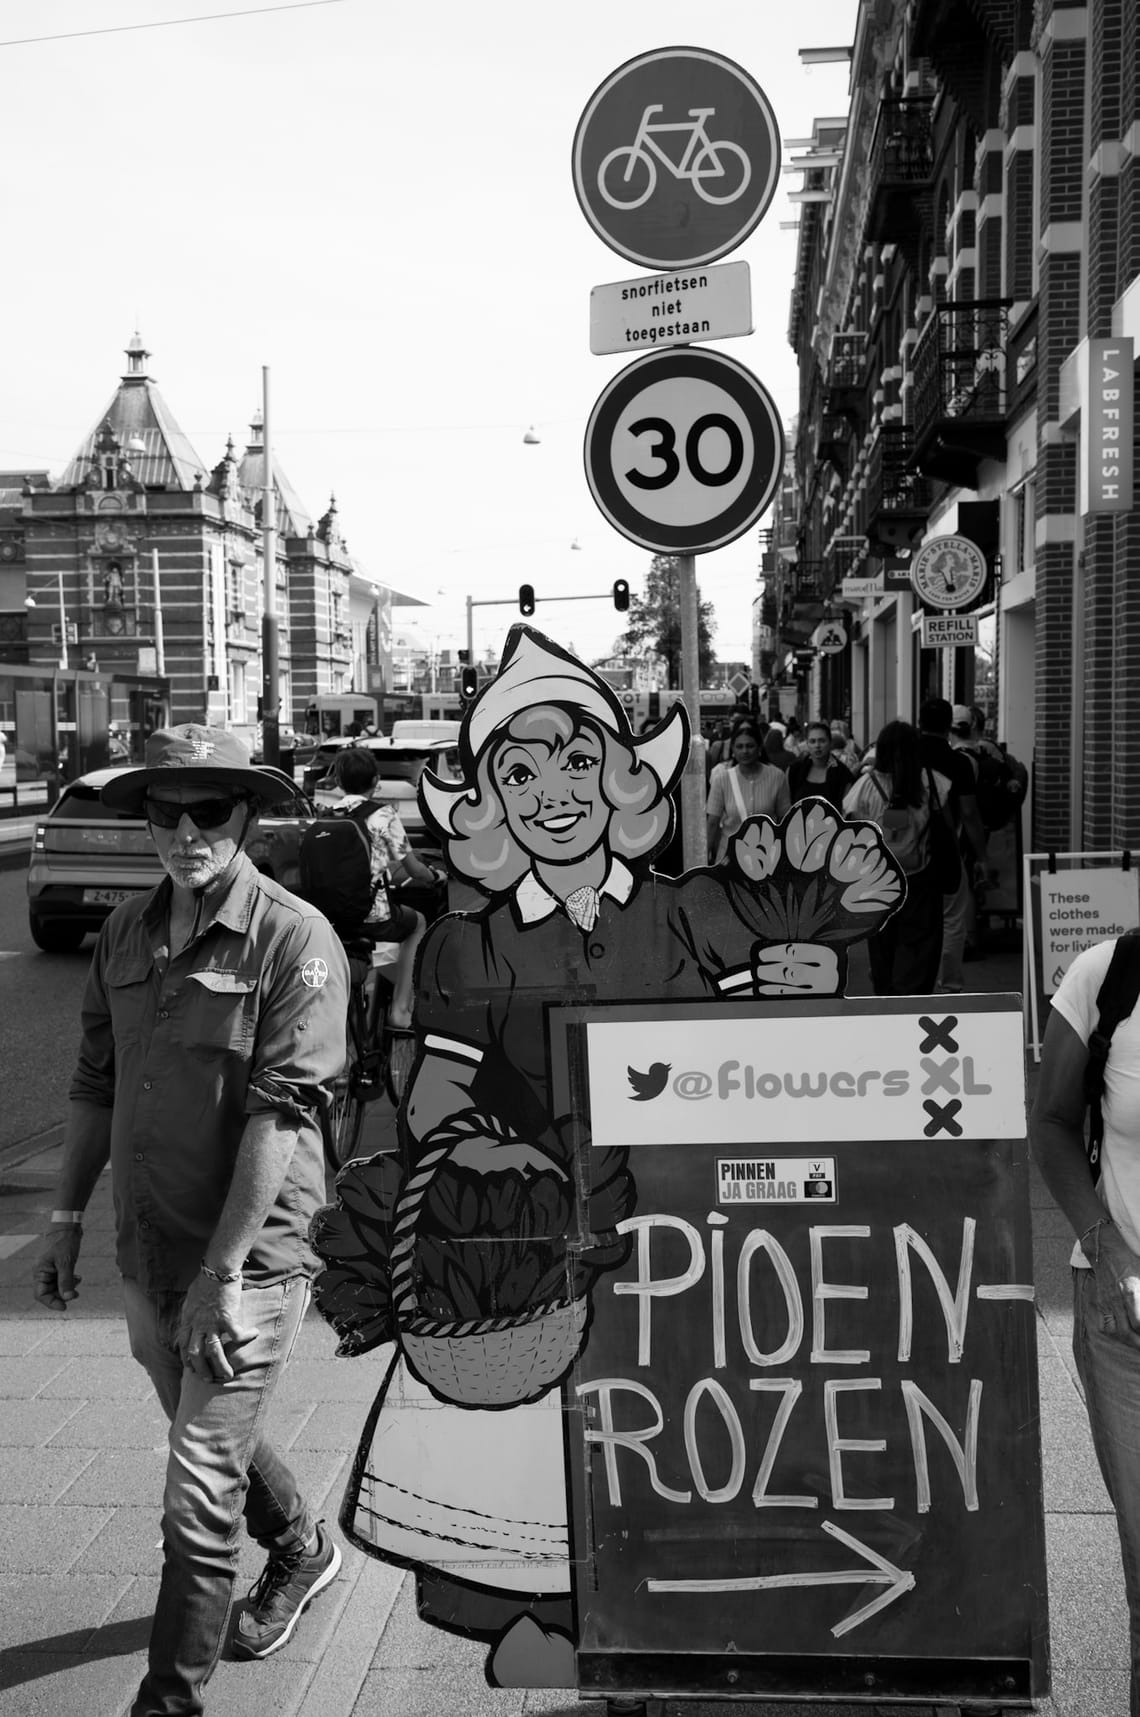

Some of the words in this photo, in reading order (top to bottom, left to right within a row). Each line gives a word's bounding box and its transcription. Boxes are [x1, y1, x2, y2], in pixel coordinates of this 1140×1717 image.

[621, 276, 707, 300] snorfietsen
[652, 299, 682, 317] niet
[625, 320, 710, 343] toegestaan
[1102, 349, 1120, 500] LABFRESH
[625, 413, 744, 491] 30
[918, 556, 930, 590] MARIE
[930, 541, 968, 555] STELLA
[970, 555, 980, 588] MARIS
[928, 619, 974, 632] REFILL
[928, 631, 974, 642] STATION
[1048, 892, 1090, 904] These
[1049, 908, 1100, 920] clothes
[1050, 926, 1084, 936] were
[1086, 923, 1125, 935] made
[1051, 941, 1069, 952] for
[673, 1060, 910, 1100] @flowers
[920, 1056, 992, 1096] XL
[721, 1163, 775, 1181] PINNEN
[722, 1182, 742, 1200] JA
[746, 1181, 797, 1199] GRAAG
[576, 1378, 983, 1513] ROZEN
